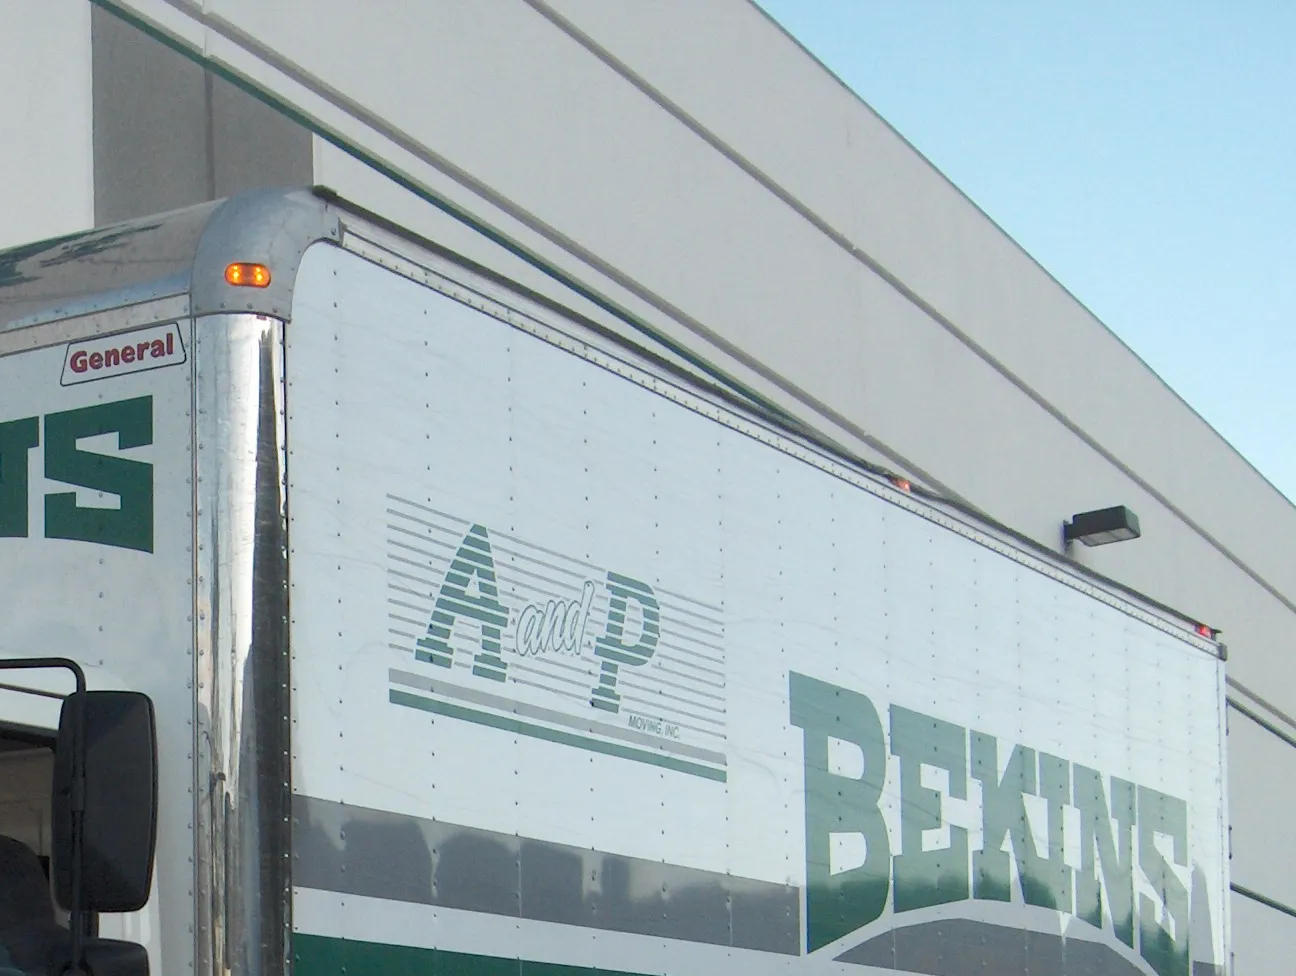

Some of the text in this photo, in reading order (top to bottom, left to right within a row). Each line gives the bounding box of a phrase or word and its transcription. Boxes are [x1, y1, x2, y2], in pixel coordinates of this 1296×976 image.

[70, 332, 174, 373] General
[414, 523, 661, 714] A and P
